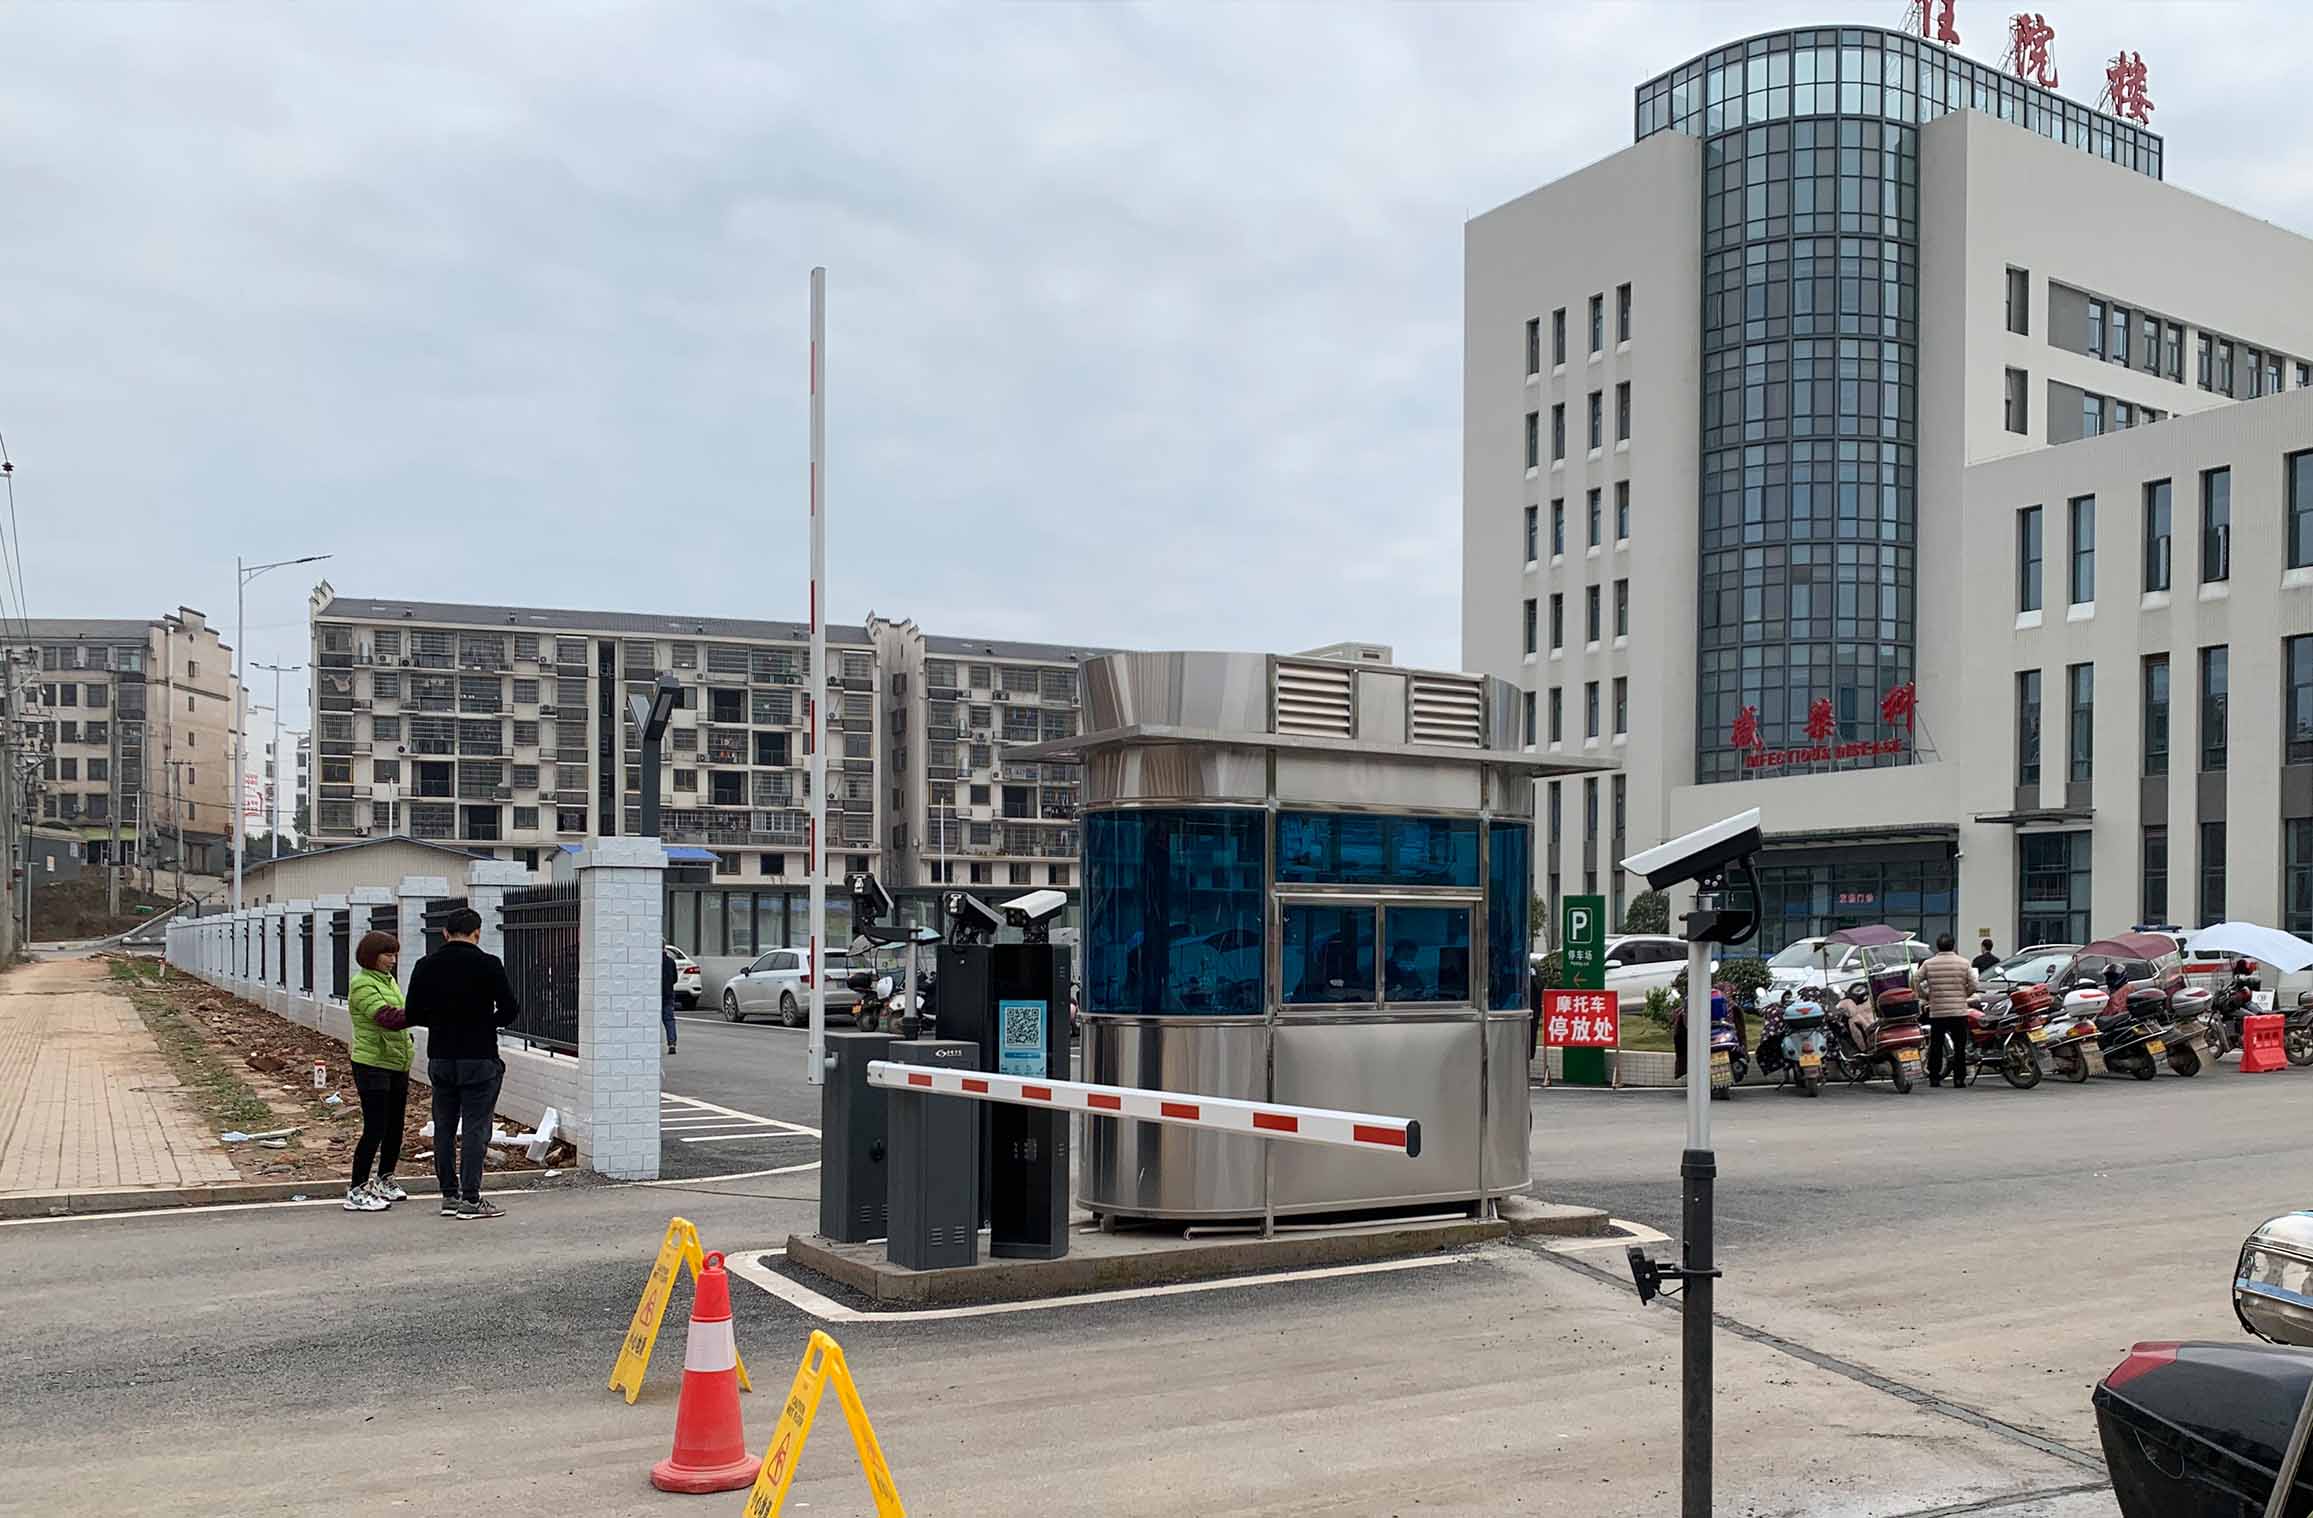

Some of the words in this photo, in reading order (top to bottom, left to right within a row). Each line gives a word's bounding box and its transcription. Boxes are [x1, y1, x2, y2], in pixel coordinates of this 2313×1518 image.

[1731, 681, 1919, 750] 感染科
[1744, 745, 1831, 768] INFECTIOUS
[1836, 738, 1902, 760] DISEASE
[1571, 911, 1588, 940] P
[1567, 950, 1593, 961] 停车场
[1556, 995, 1606, 1013] 摩托车
[1548, 1016, 1614, 1042] 停放处
